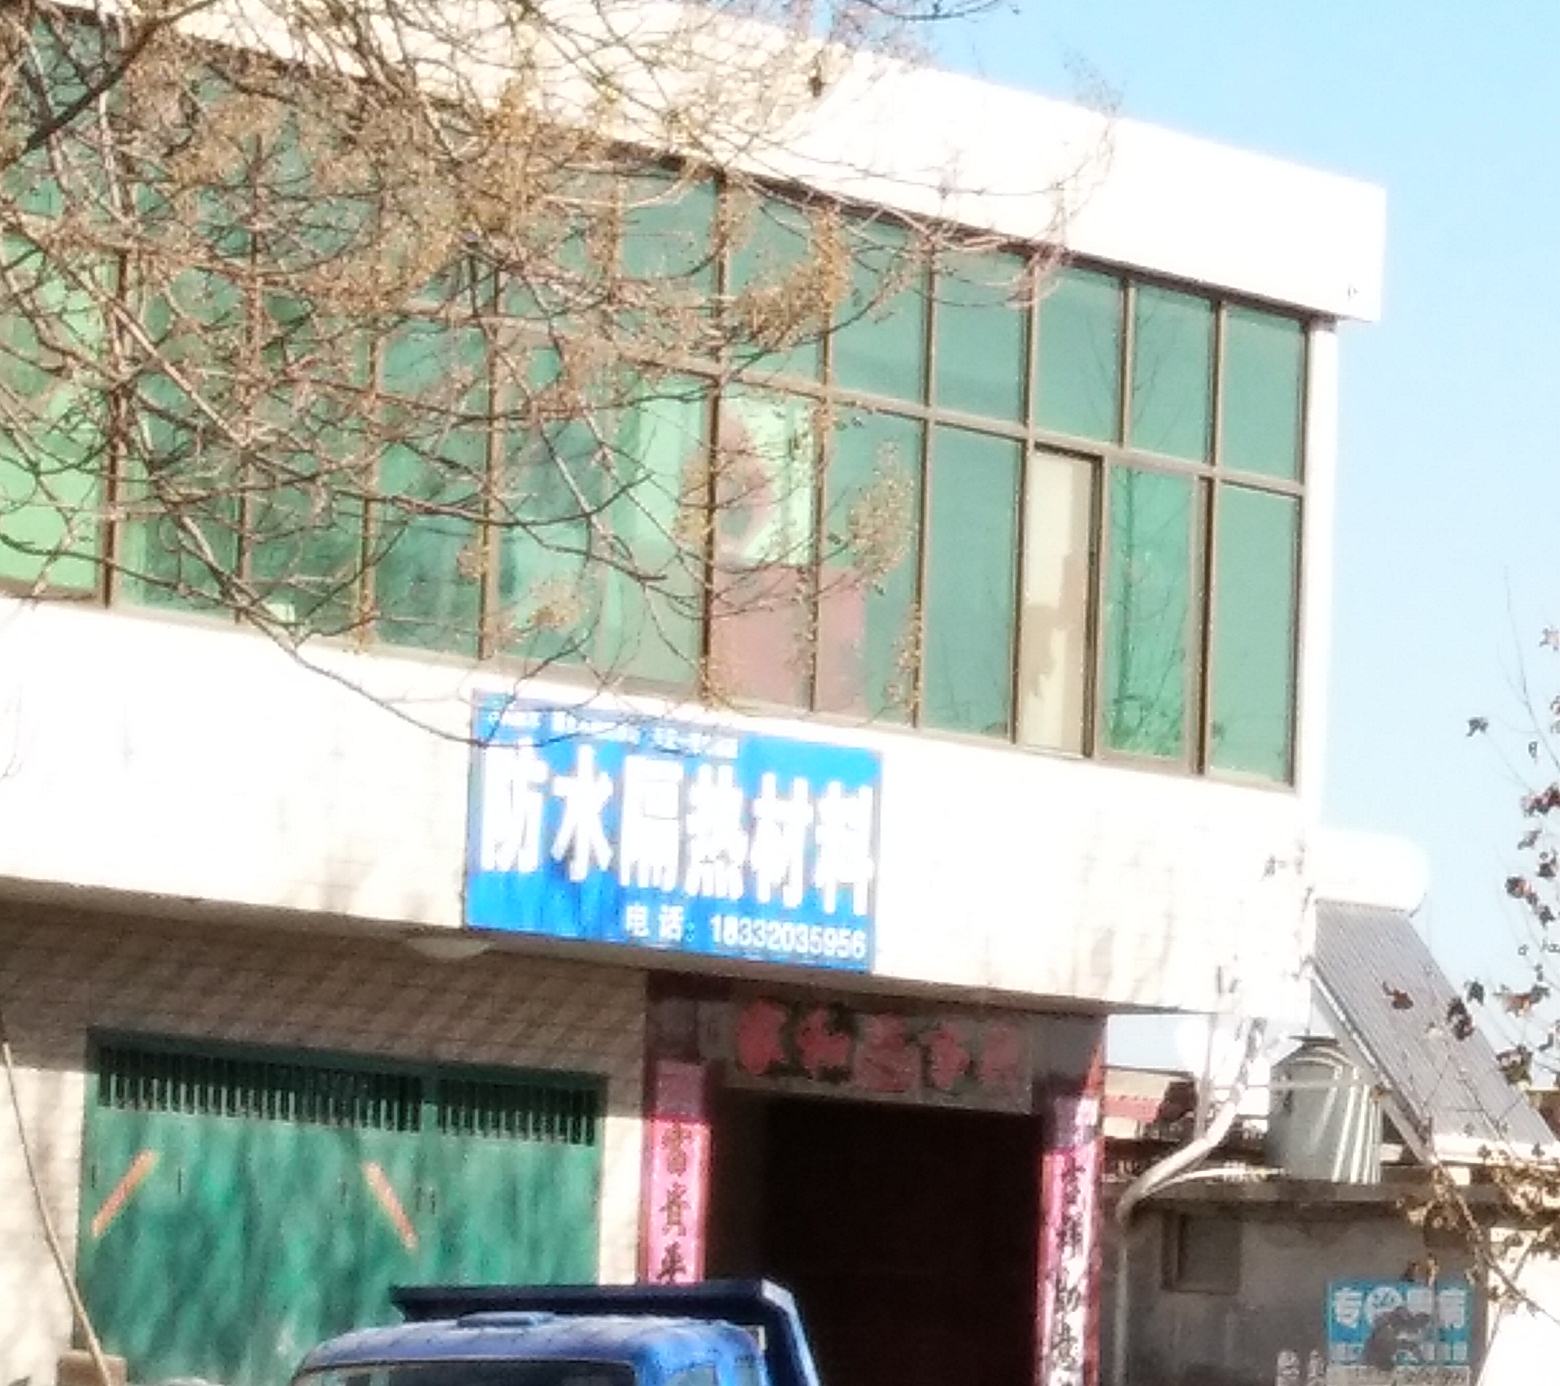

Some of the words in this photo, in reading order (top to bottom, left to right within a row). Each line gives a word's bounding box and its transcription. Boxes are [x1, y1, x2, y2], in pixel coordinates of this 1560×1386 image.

[480, 736, 877, 917] 防水隔热材料
[710, 913, 867, 959] 18332035956
